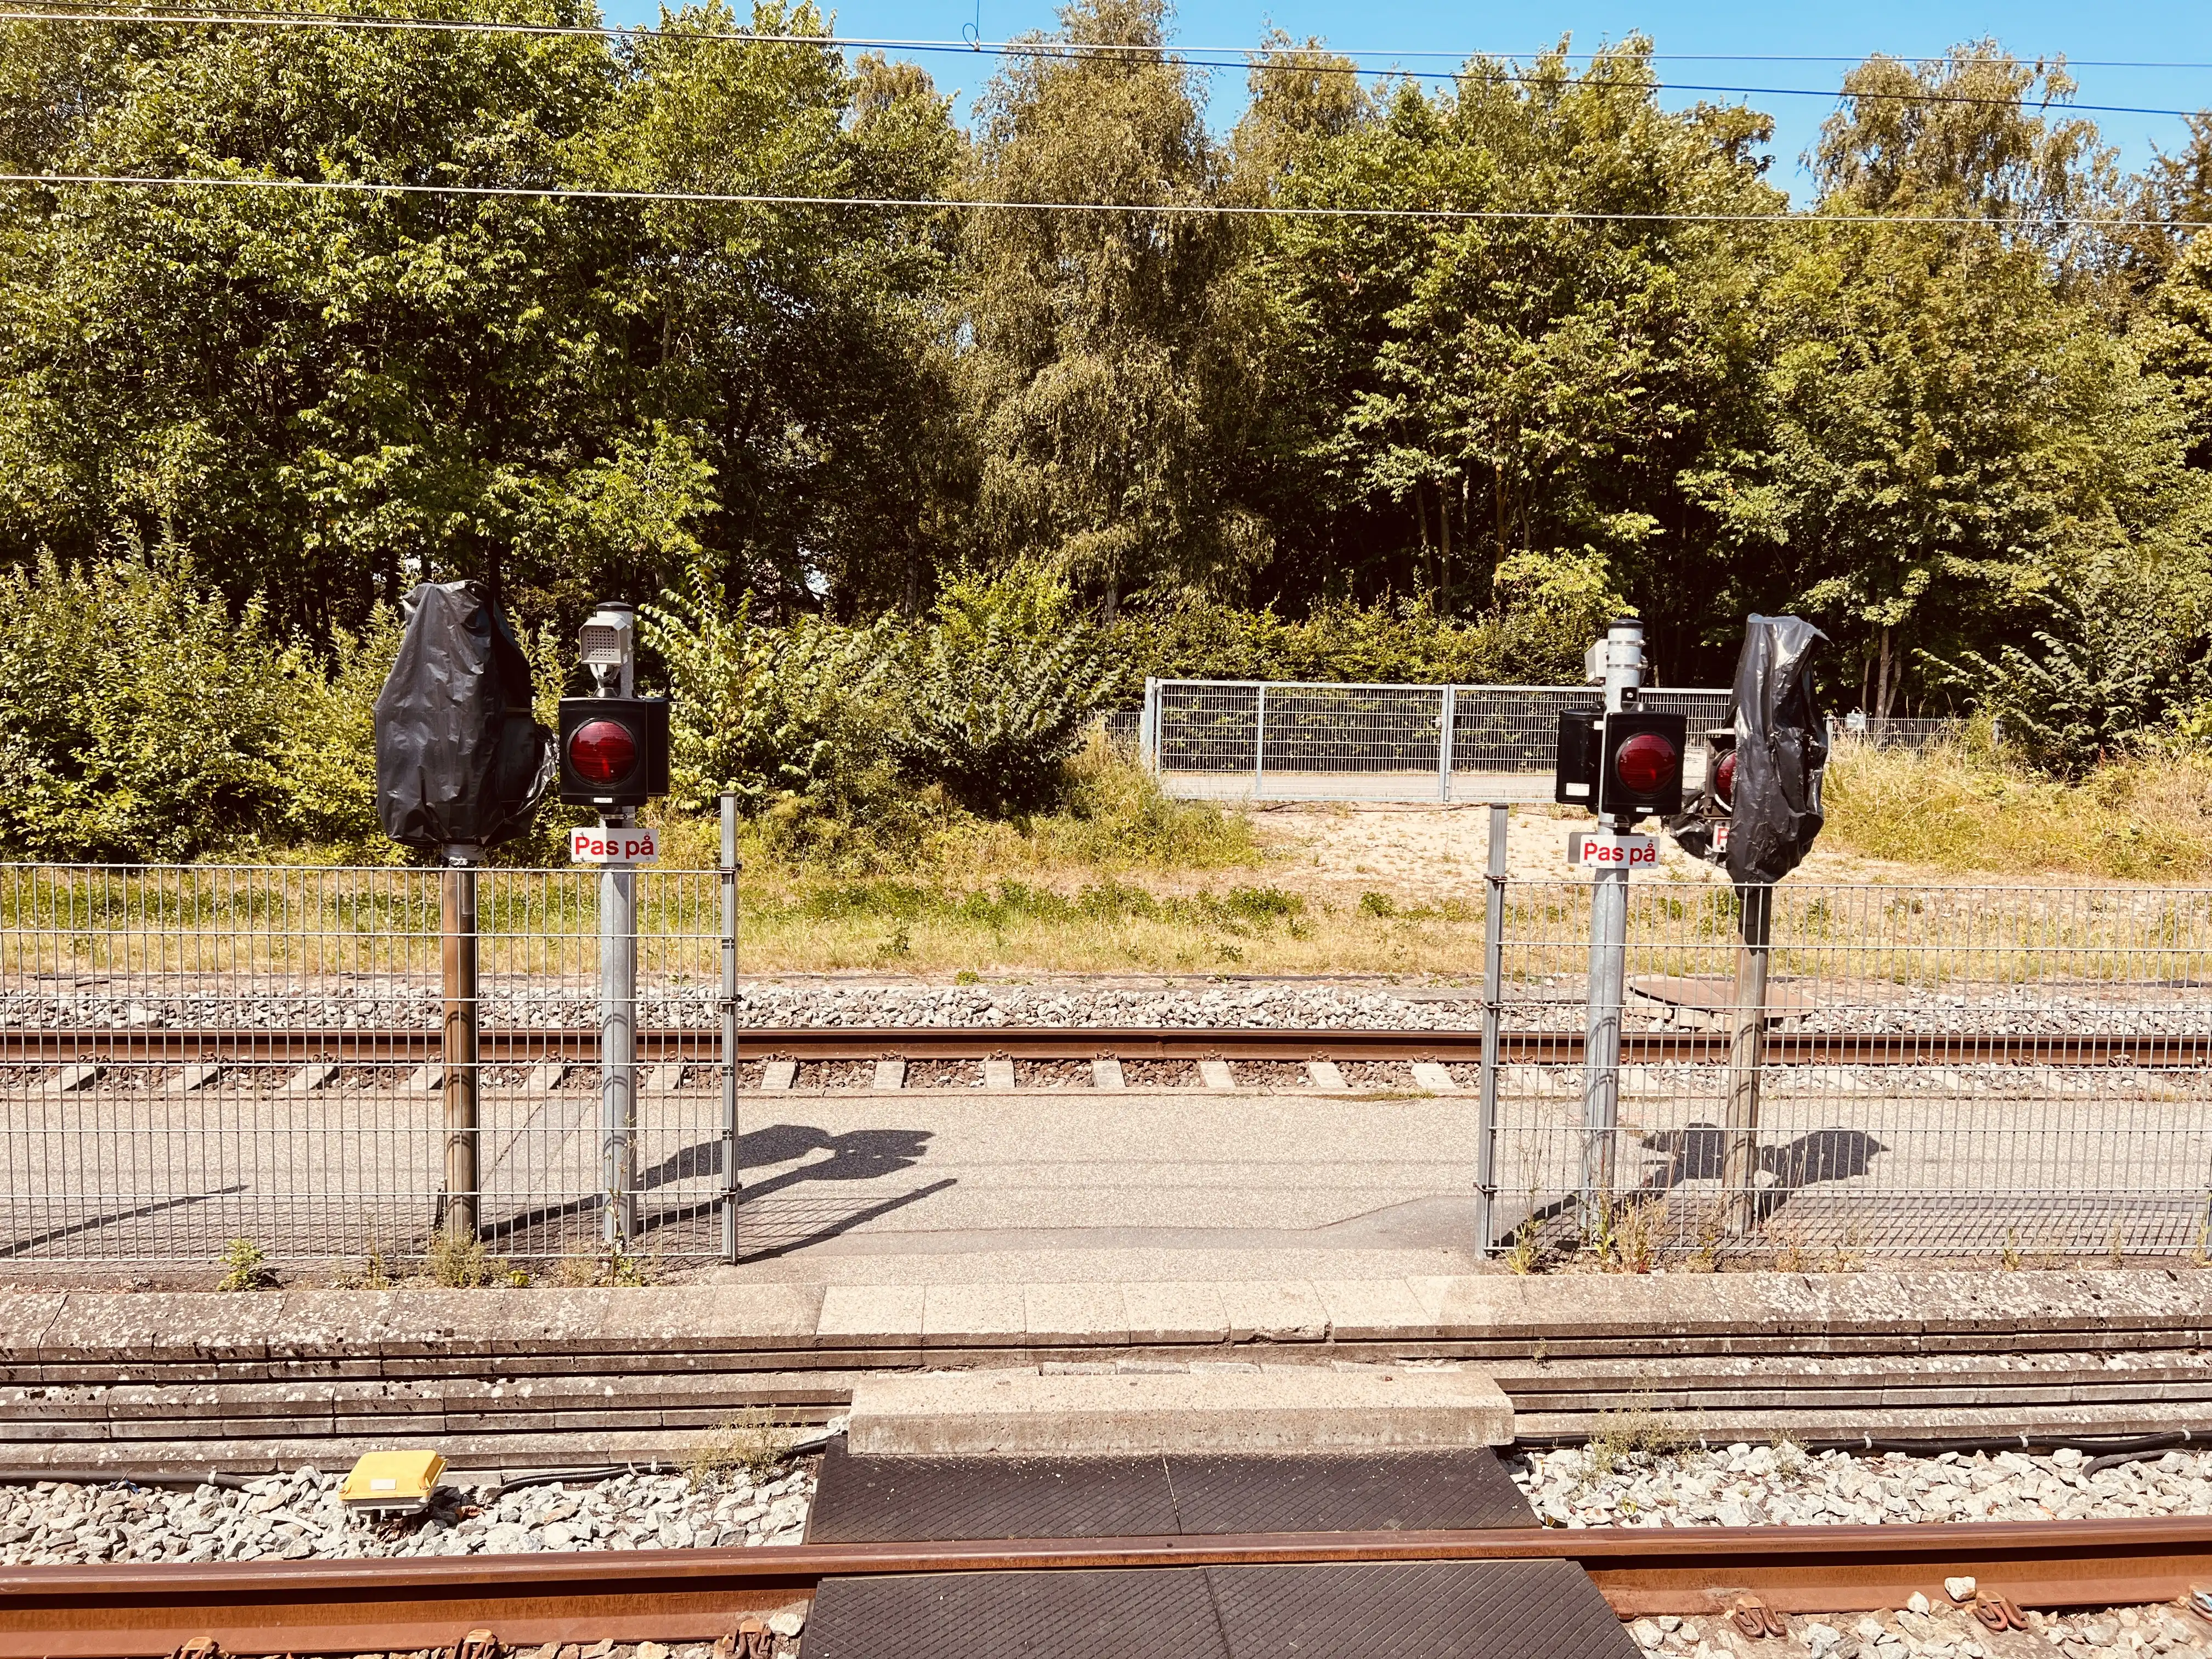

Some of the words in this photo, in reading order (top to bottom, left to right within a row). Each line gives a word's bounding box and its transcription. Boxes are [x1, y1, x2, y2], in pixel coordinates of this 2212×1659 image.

[575, 837, 619, 855] Pas
[625, 835, 654, 859] på
[1584, 843, 1624, 862] Pas
[1629, 843, 1656, 865] på
